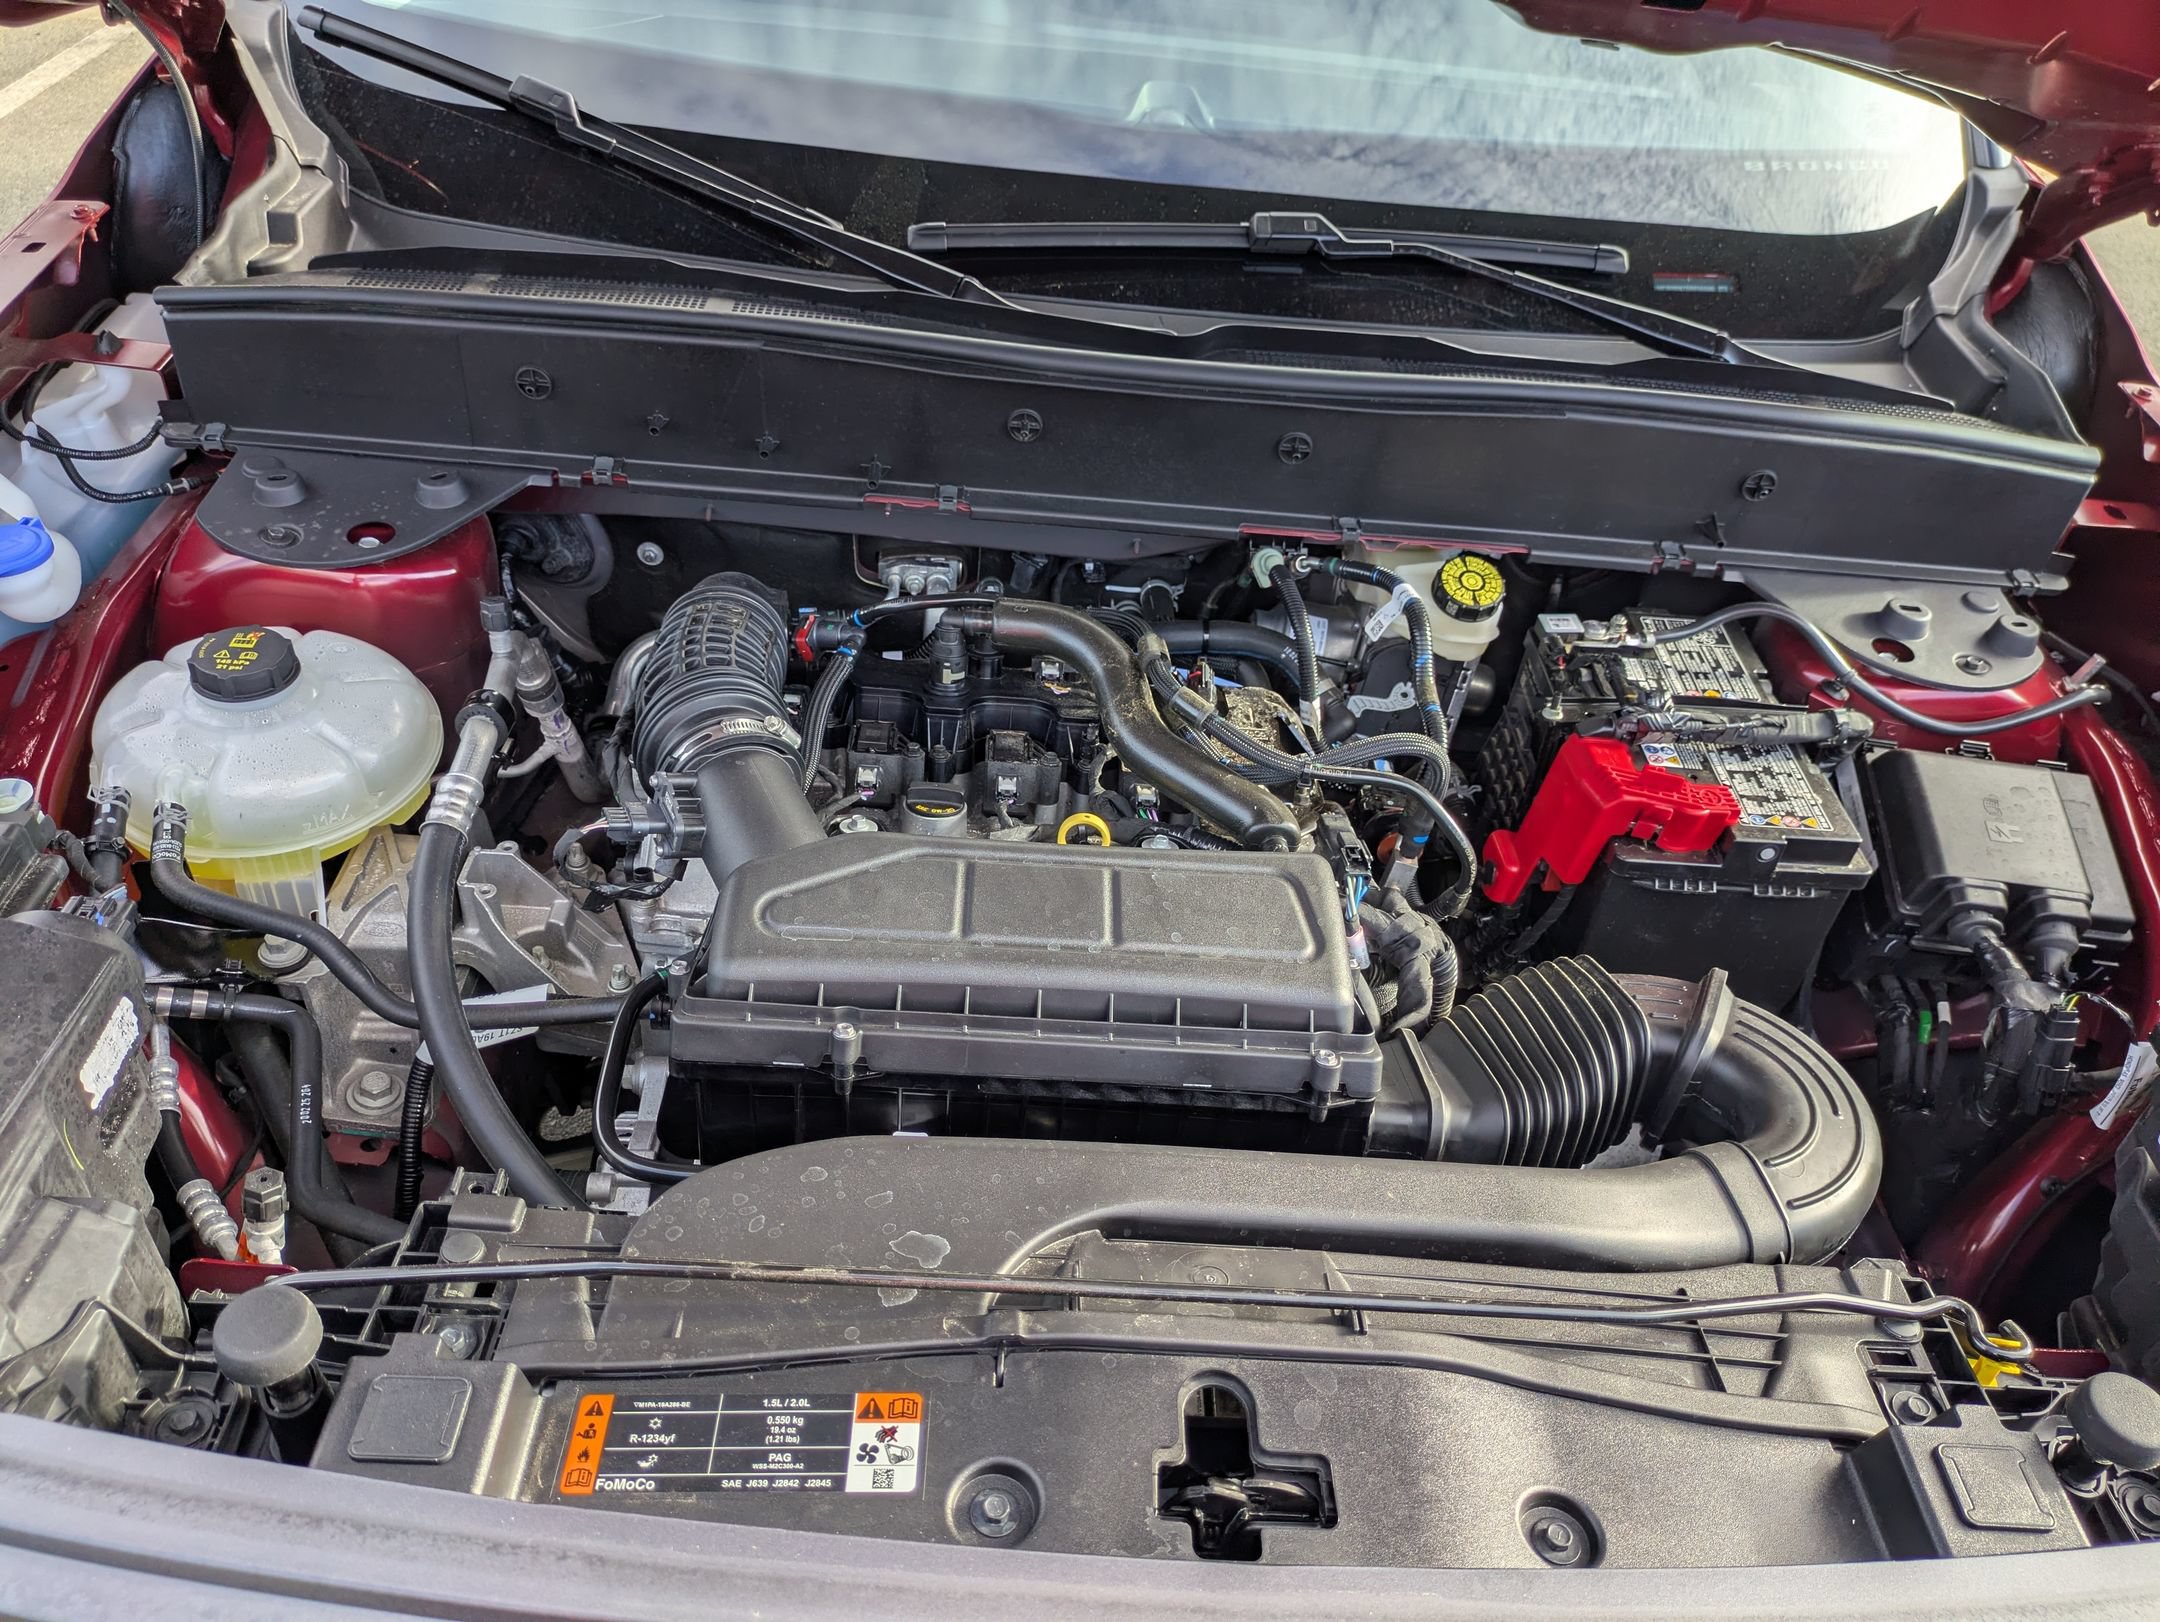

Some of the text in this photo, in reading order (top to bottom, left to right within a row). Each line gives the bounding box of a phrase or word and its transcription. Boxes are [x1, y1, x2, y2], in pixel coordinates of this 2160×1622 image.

[762, 1398, 782, 1407] 1.5L
[790, 1398, 811, 1407] 2.0L
[767, 1415, 804, 1426] 0.550 kg
[770, 1426, 786, 1434] 19.4
[629, 1433, 676, 1446] R-1234yf
[765, 1435, 800, 1444] (1.21 lbs)
[768, 1453, 792, 1462] PAG
[594, 1476, 656, 1491] FoMoCo
[721, 1479, 832, 1488] SAE J639 J2842 J2845
